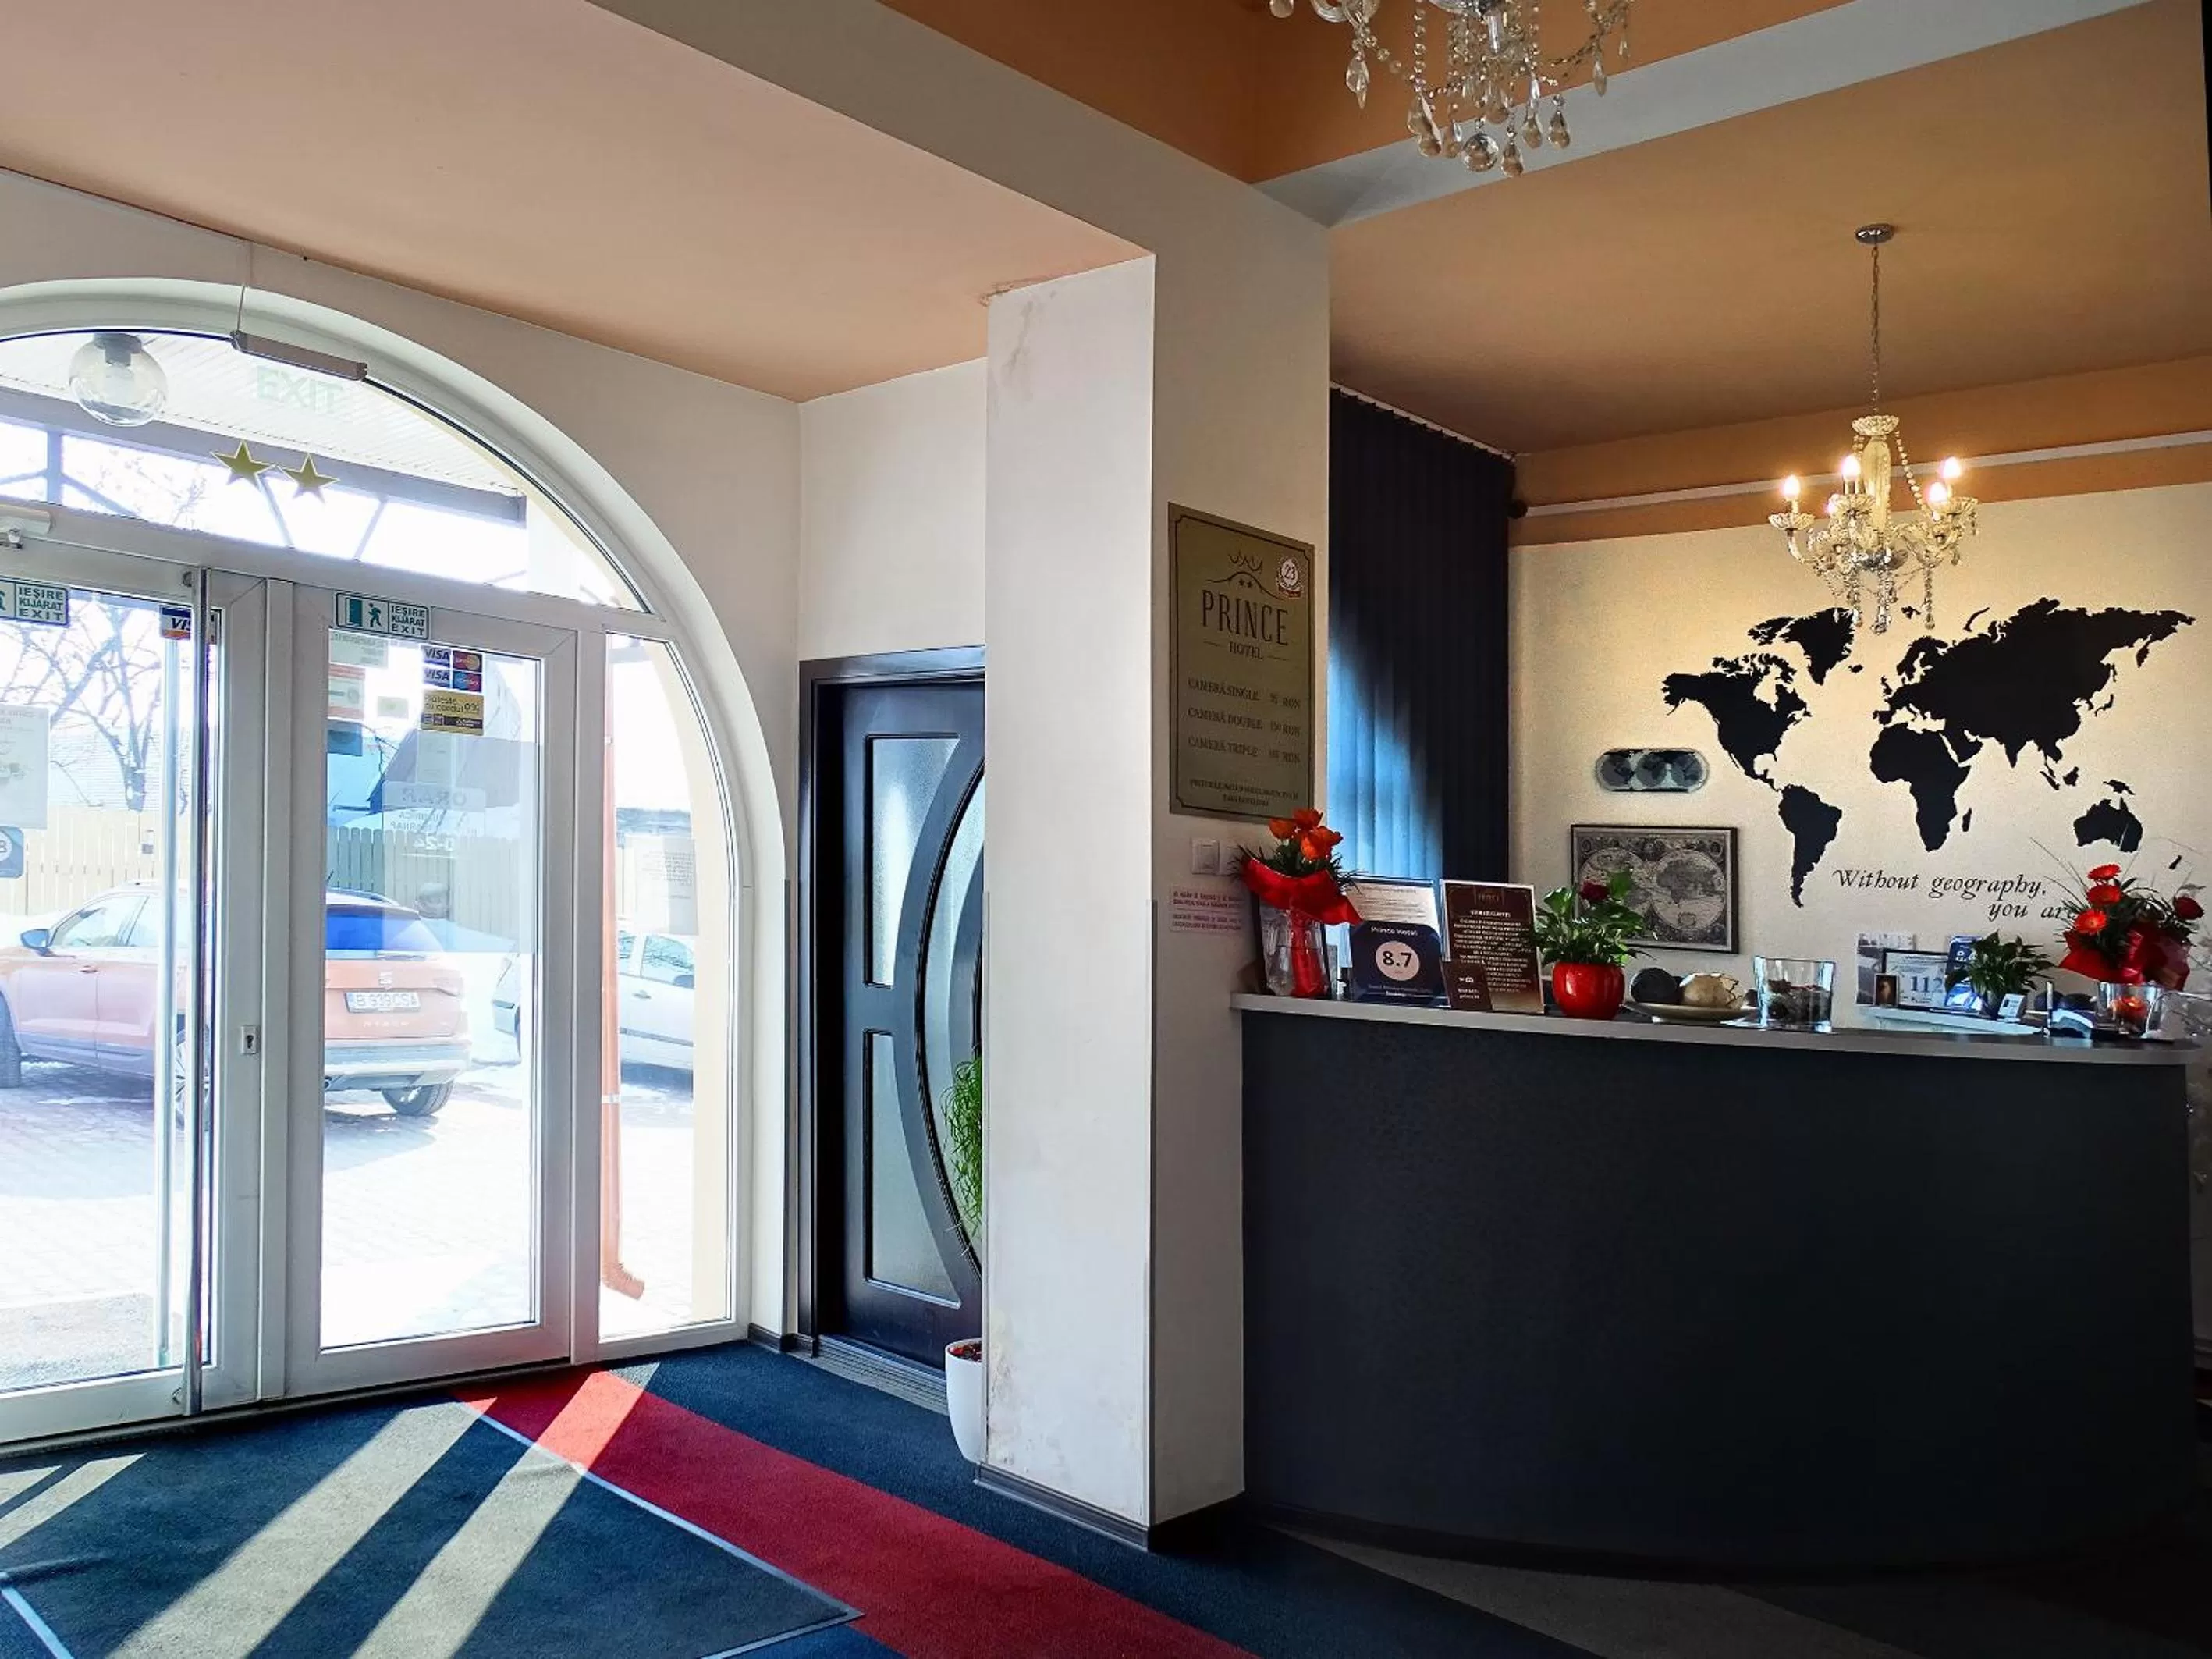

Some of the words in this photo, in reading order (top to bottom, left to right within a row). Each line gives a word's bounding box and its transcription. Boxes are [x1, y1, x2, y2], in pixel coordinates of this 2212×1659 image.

[257, 365, 344, 415] EXIT
[19, 609, 64, 621] EXIT
[1201, 589, 1289, 646] PRINCE
[392, 623, 425, 636] EXIT
[424, 648, 451, 661] VISA
[1229, 641, 1263, 660] HOTEL
[424, 668, 450, 681] VISA
[1831, 869, 1919, 890] Without
[1928, 874, 2047, 901] geography,
[1987, 902, 2028, 922] you
[1382, 950, 1413, 968] 8.7
[1911, 975, 1944, 993] 112
